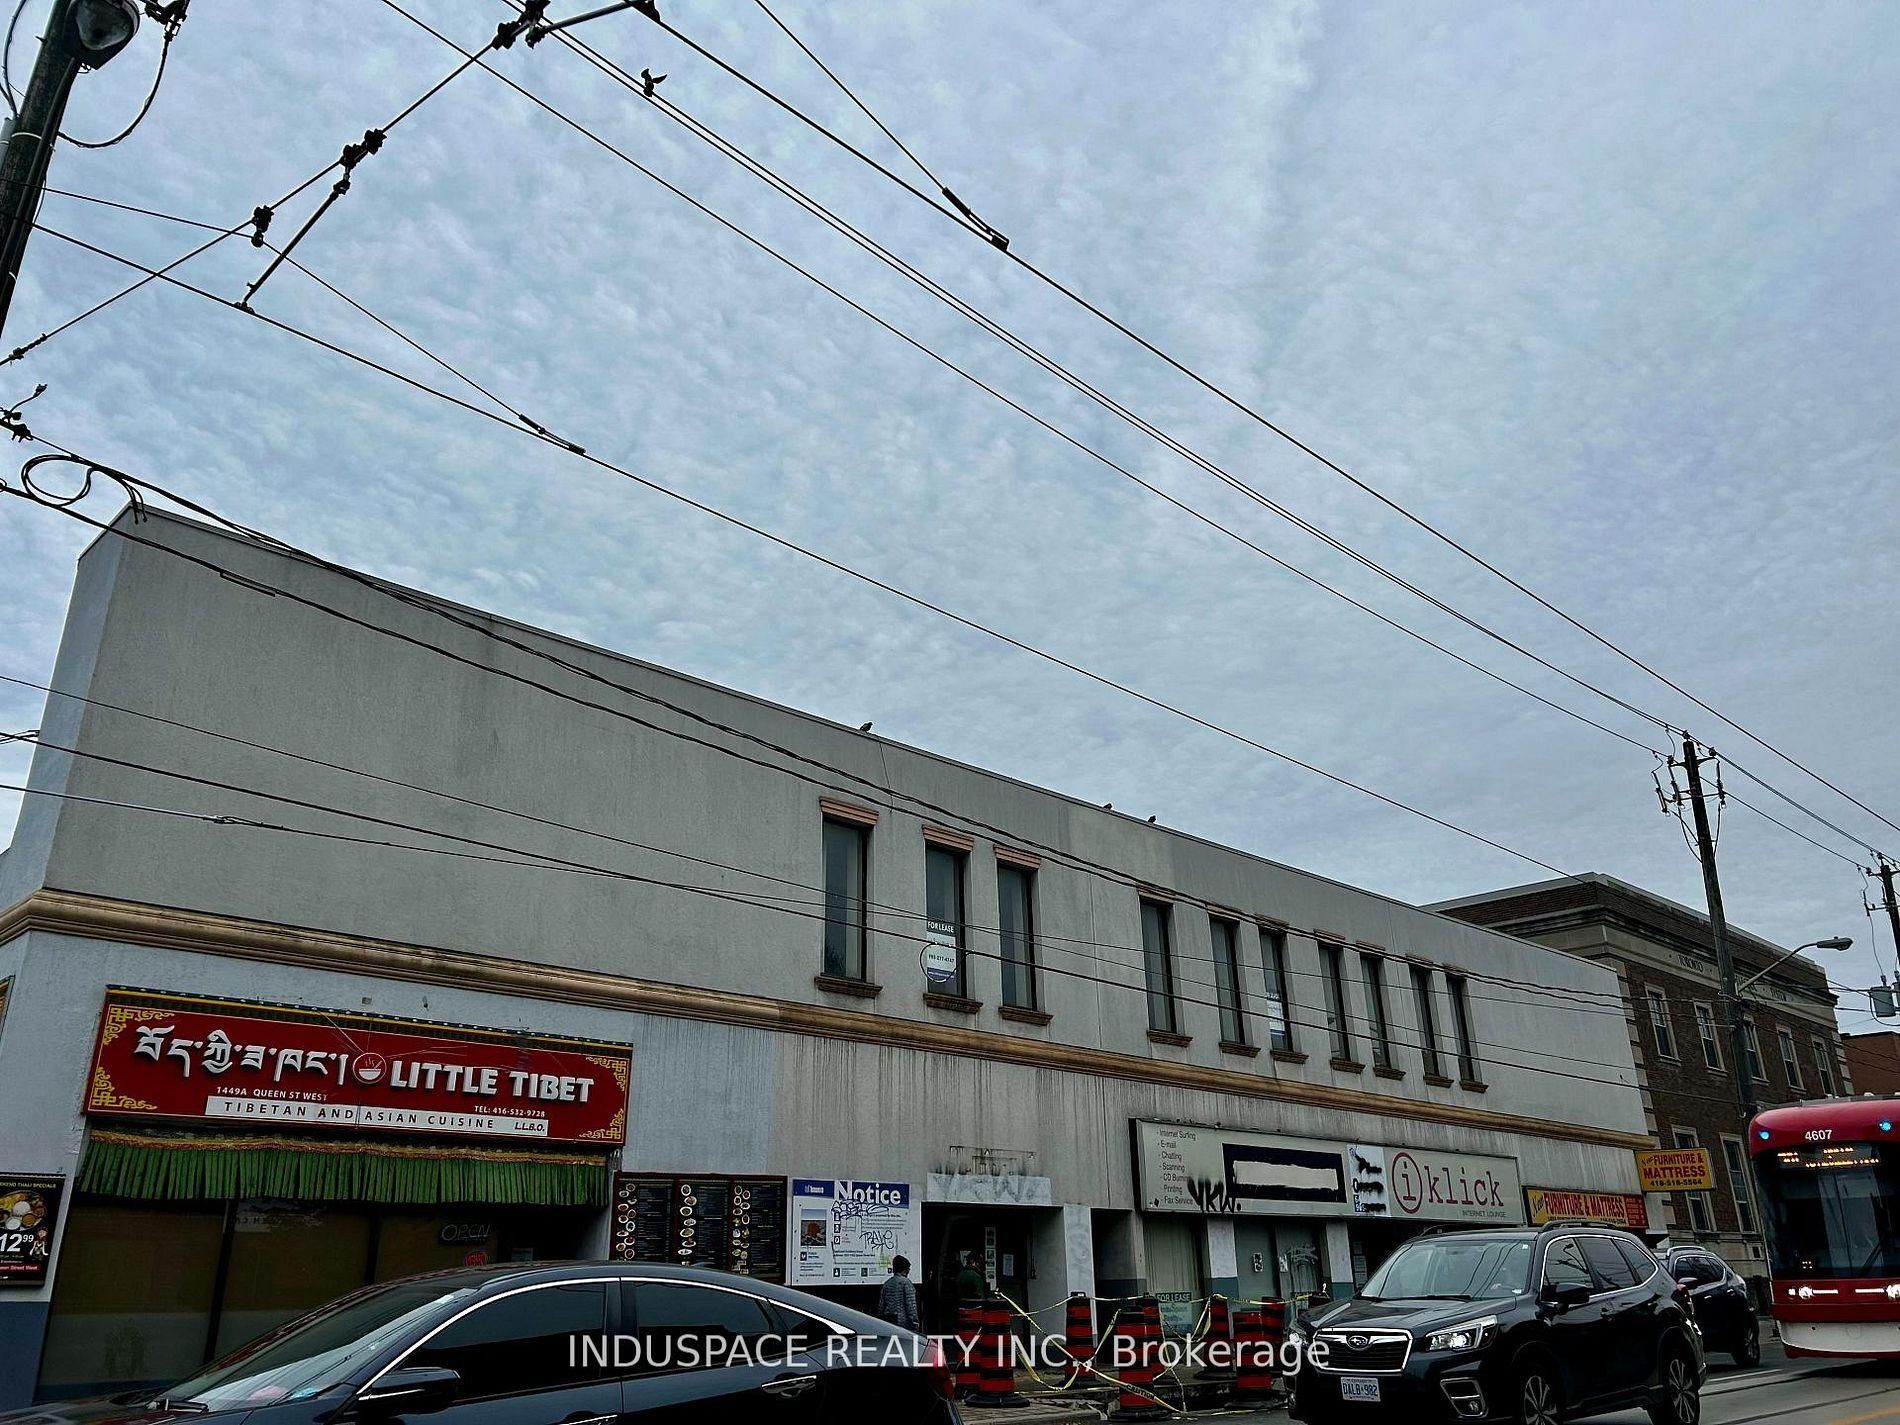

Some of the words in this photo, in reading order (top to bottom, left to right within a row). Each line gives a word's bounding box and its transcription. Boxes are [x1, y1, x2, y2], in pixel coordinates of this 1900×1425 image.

[927, 921, 938, 930] FOR
[938, 923, 954, 932] LEASE
[1678, 954, 1704, 973] TORONTO
[390, 1060, 498, 1096] LITTLE
[509, 1071, 594, 1103] TIBET
[216, 1086, 248, 1096] 1449A
[253, 1088, 286, 1099] QUEEN
[288, 1090, 301, 1100] ST
[302, 1091, 328, 1102] WEST
[224, 1101, 307, 1117] TIBETAN
[317, 1109, 354, 1120] AND
[364, 1111, 418, 1124] ASIAN
[427, 1115, 495, 1129] CUISINE
[474, 1105, 491, 1115] TEL:
[492, 1106, 546, 1118] 416-532-9728
[1160, 1129, 1178, 1138] Internet
[1179, 1130, 1196, 1141] Surfing
[1805, 1129, 1833, 1141] 4607
[1160, 1140, 1177, 1148] E-mail
[1161, 1151, 1182, 1161] Chatting
[1654, 1152, 1696, 1166] FURNITURE
[1697, 1152, 1704, 1164] &
[1162, 1162, 1185, 1173] Scanning
[1643, 1164, 1706, 1180] MATTRESS
[1163, 1173, 1172, 1181] CD
[1164, 1185, 1183, 1195] Printing
[1424, 1165, 1504, 1207] klick
[834, 1181, 901, 1205] Notice
[1164, 1195, 1174, 1204] Fax
[1543, 1192, 1585, 1217] FURNITURE
[1584, 1194, 1591, 1217] &
[1590, 1195, 1625, 1219] MATTRESS
[1462, 1209, 1486, 1218] INTERNET
[1486, 1210, 1507, 1219] LOUNGE
[1171, 1292, 1192, 1302] LEASE
